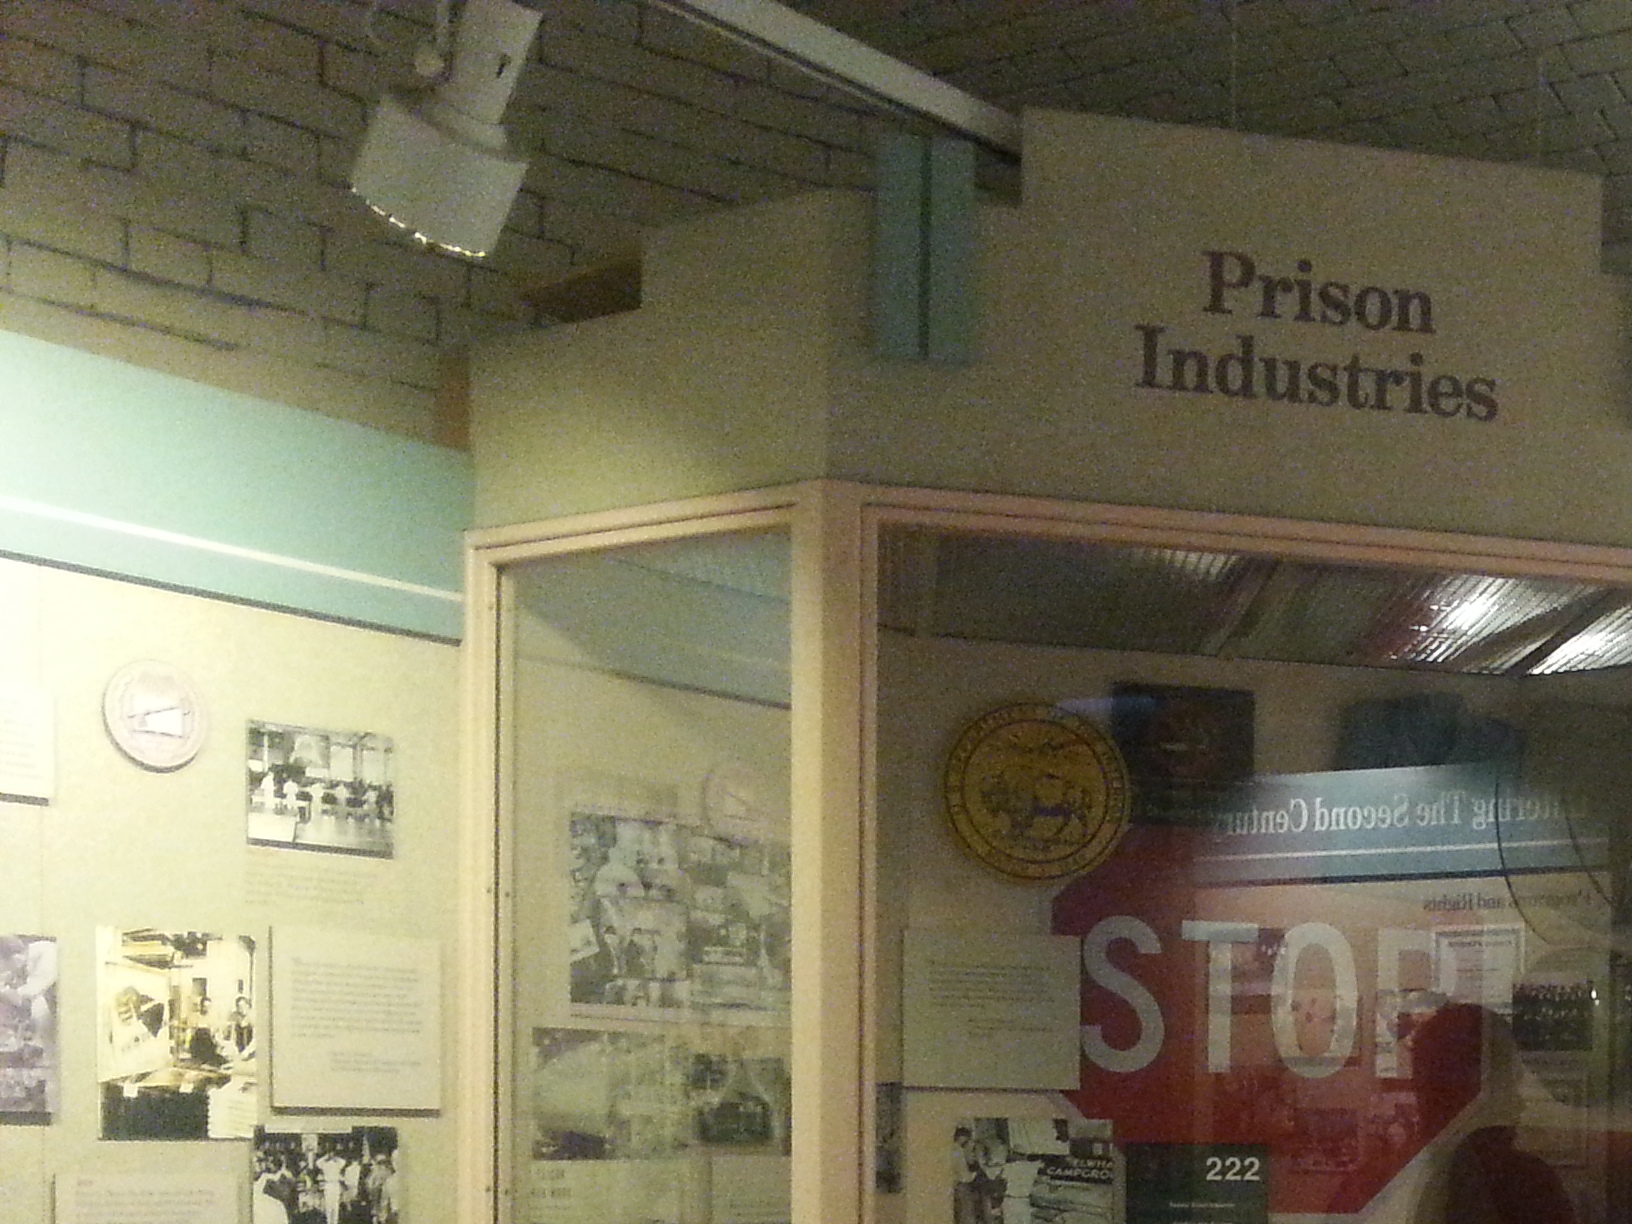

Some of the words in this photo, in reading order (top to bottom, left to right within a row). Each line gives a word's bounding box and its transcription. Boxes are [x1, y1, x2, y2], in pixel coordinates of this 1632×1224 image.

[1202, 250, 1436, 334] Prison
[1134, 323, 1500, 422] Industries
[1082, 914, 1462, 1080] STOP
[1205, 1156, 1261, 1181] 222
